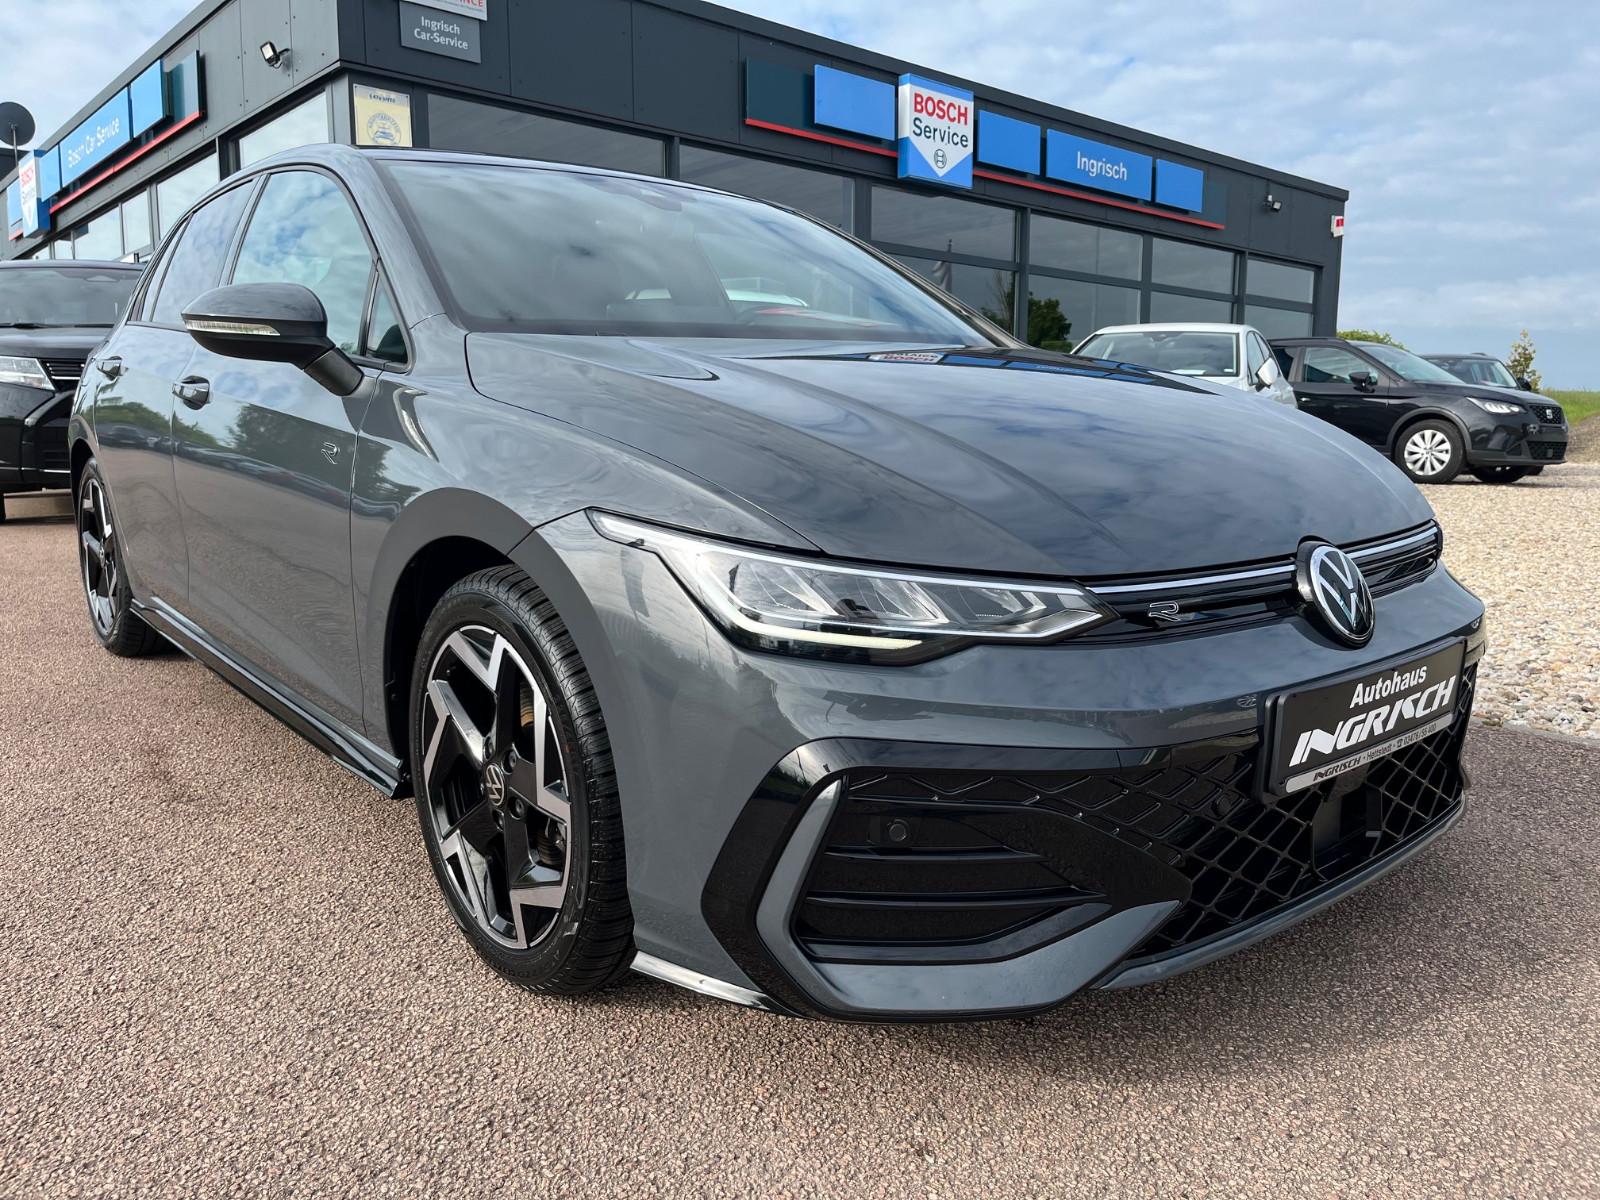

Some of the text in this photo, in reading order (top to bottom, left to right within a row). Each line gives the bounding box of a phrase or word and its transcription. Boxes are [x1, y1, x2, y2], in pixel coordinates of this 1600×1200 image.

[413, 28, 469, 50] Car-Service
[421, 15, 461, 36] Ingrisch
[913, 92, 968, 126] BOSCH
[96, 117, 120, 147] Service
[912, 117, 969, 148] Service
[1076, 151, 1128, 181] Ingrisch
[1349, 665, 1428, 709] Autohaus
[1288, 675, 1457, 768] INGRISCH
[1312, 755, 1362, 782] INGRISCH
